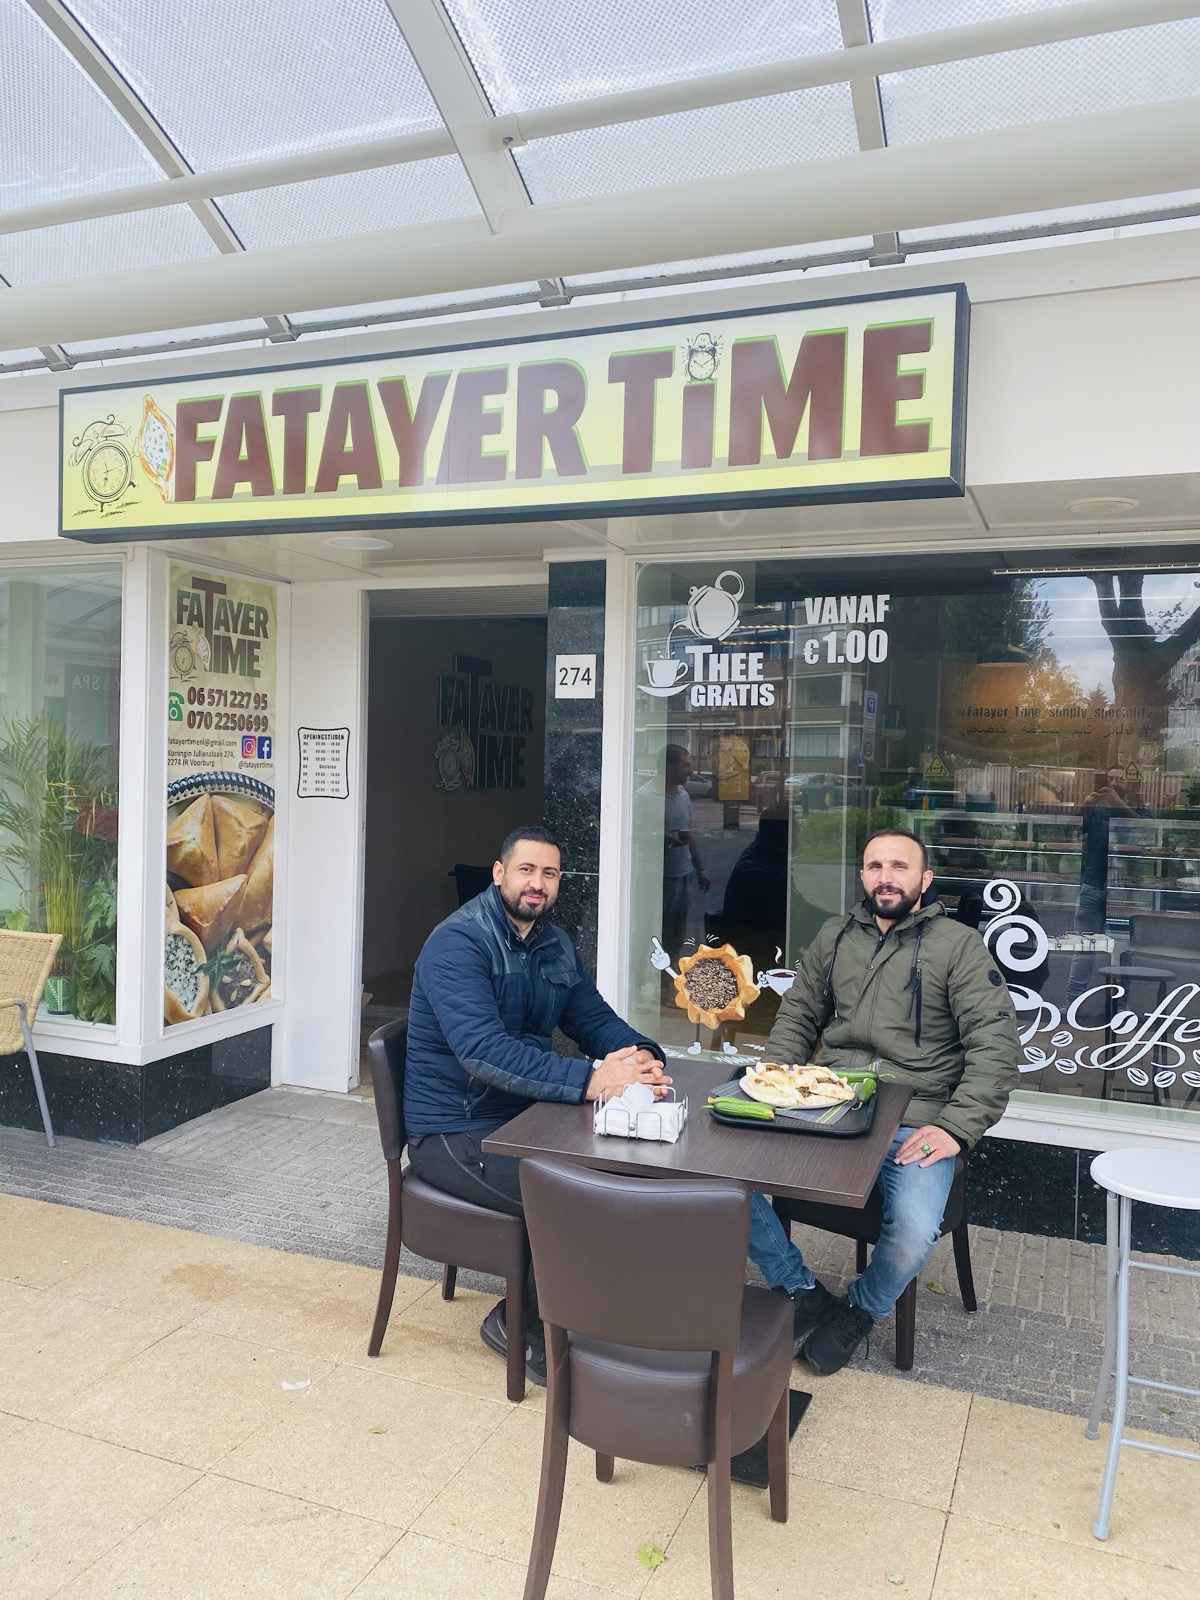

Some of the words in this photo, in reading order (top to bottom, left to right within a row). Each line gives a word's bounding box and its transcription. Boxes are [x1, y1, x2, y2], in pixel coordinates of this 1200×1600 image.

[175, 358, 589, 501] FATAYER
[176, 576, 269, 639] FATAYER
[804, 594, 890, 625] VANAF
[822, 629, 889, 664] 1.00
[685, 645, 764, 682] THEE
[559, 667, 592, 686] 274
[187, 686, 206, 706] 06
[253, 692, 268, 711] 95
[690, 683, 775, 707] GRATIS
[187, 710, 213, 729] 070
[214, 712, 269, 732] 2250699
[168, 749, 193, 759] Koningin
[168, 758, 181, 766] 2274
[190, 759, 215, 768] Voorburg
[238, 761, 273, 769] @fatayertime
